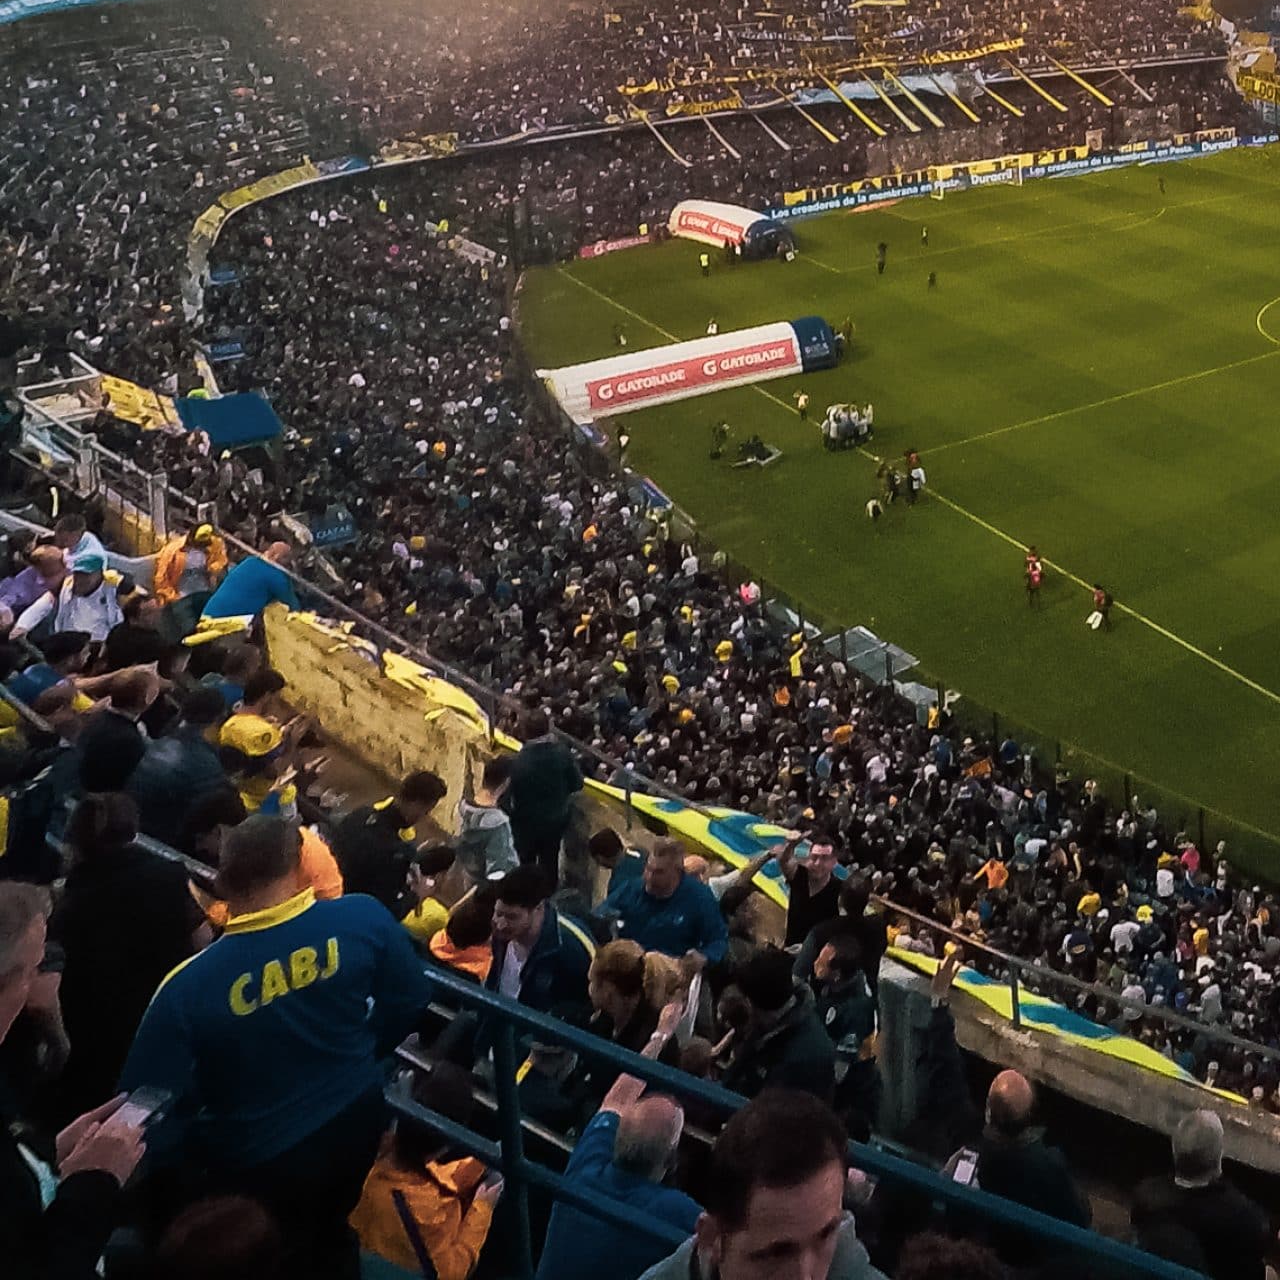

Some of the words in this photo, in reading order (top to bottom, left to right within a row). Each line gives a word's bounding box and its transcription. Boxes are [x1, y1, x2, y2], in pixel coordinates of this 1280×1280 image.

[770, 207, 790, 219] Los
[792, 198, 841, 216] creadores
[843, 195, 856, 207] de
[869, 185, 918, 202] membrana
[920, 182, 933, 192] en
[598, 383, 614, 400] G
[616, 369, 687, 395] GATORADE
[703, 359, 718, 376] G
[720, 347, 787, 371] GATORADE
[229, 937, 341, 1016] CABJ
